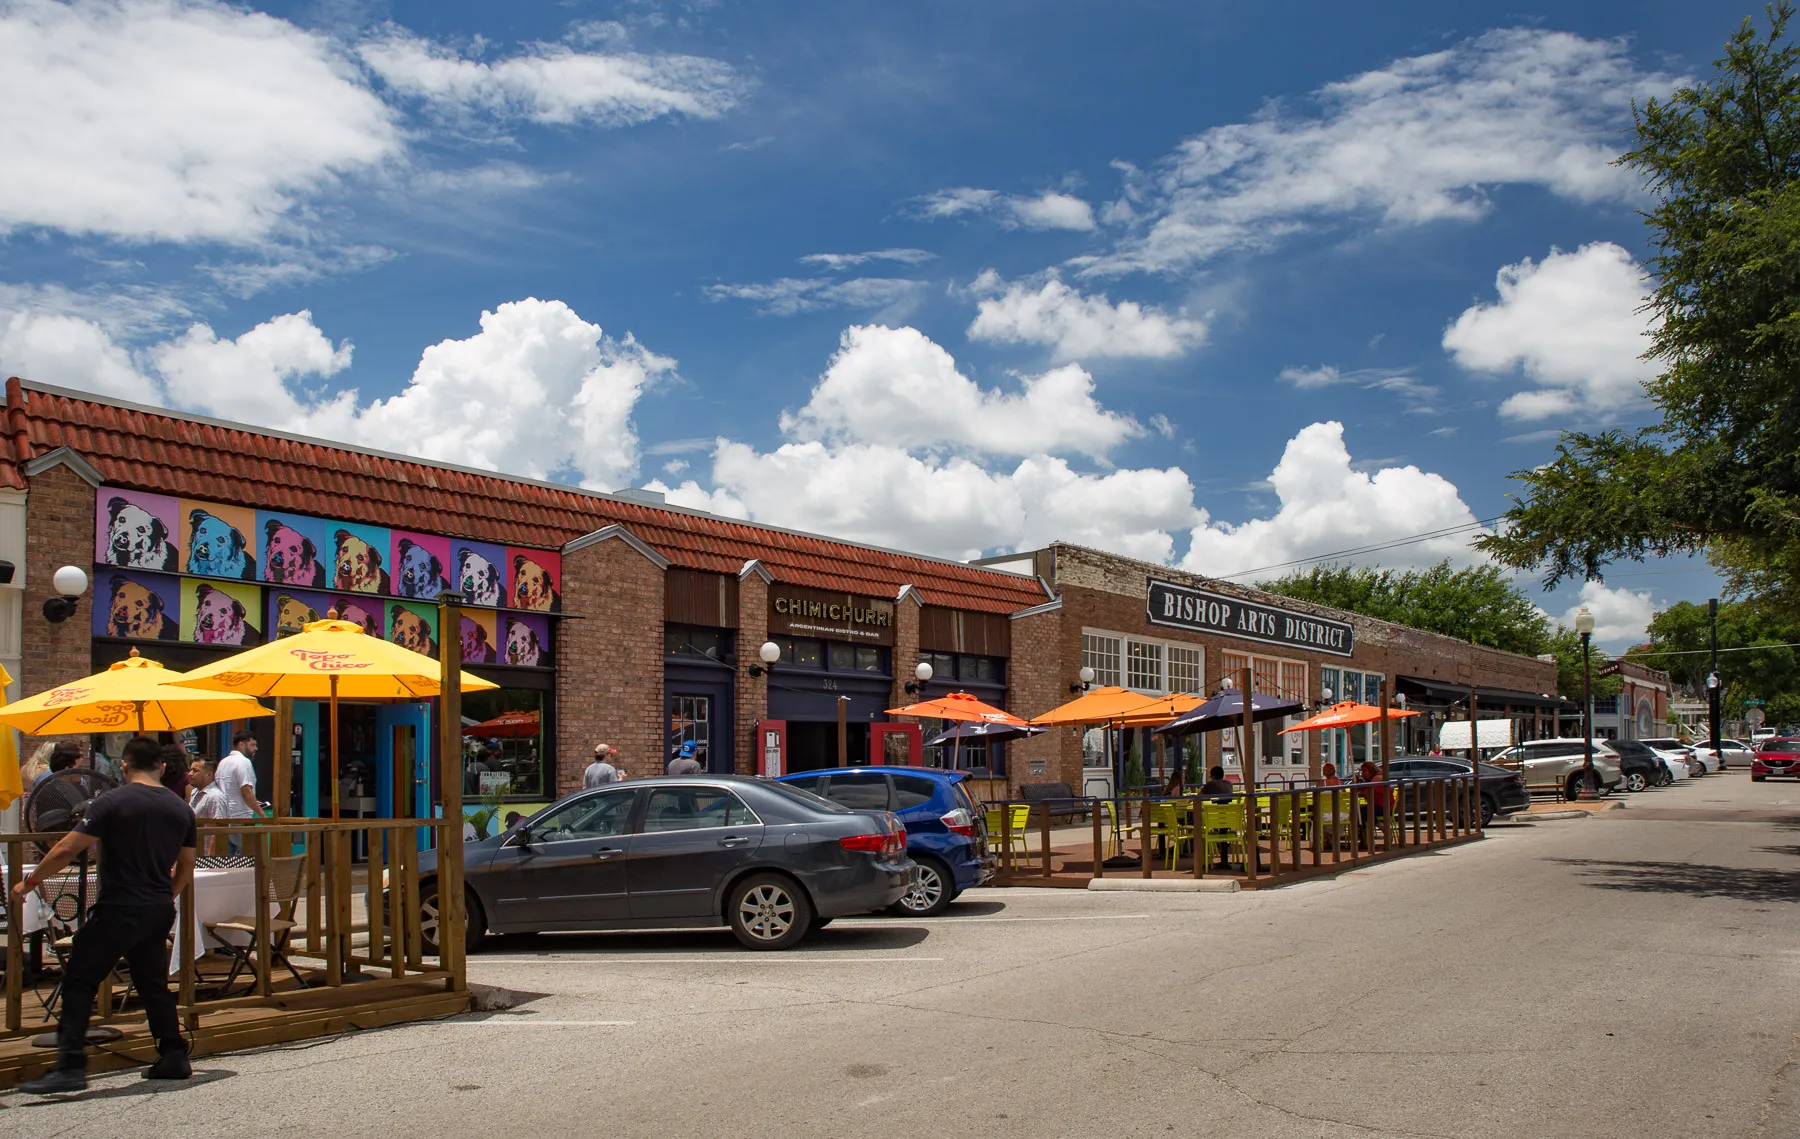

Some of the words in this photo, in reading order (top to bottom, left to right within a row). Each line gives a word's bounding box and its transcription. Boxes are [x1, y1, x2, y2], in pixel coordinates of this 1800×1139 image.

[775, 597, 893, 626] CHIMICHURRI
[1163, 592, 1231, 627] BISHOP
[1237, 608, 1276, 636] ARTS
[1285, 617, 1345, 649] DISTRICT
[789, 623, 834, 633] ARGENTINIAN
[835, 628, 859, 636] BISTRO
[290, 649, 356, 661] Topo
[309, 660, 375, 671] Chico
[823, 679, 837, 690] 324
